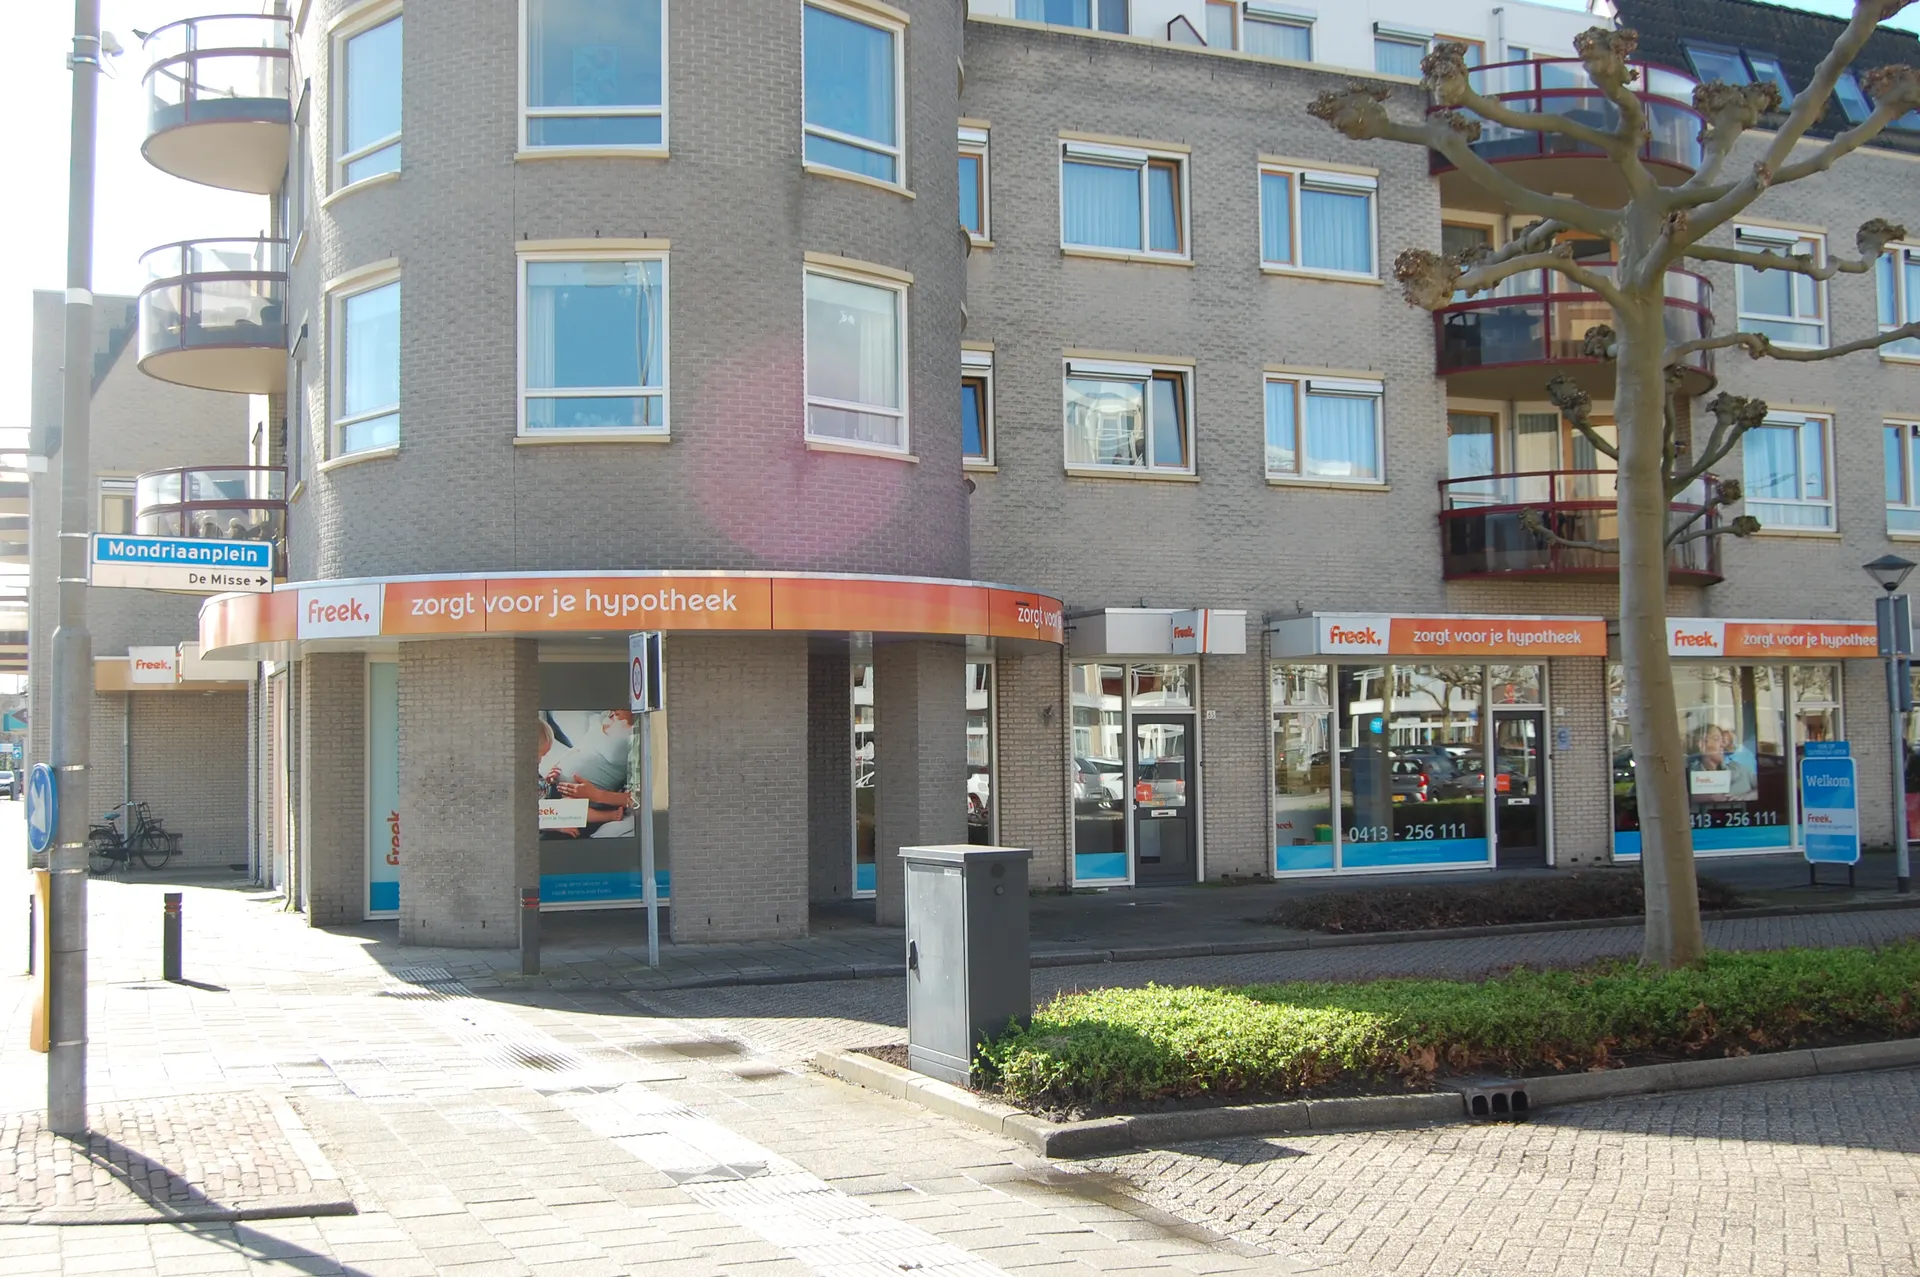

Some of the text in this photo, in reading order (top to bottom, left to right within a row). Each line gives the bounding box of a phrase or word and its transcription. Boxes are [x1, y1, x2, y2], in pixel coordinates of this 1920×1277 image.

[108, 540, 258, 563] Mondriaanplein
[189, 573, 251, 586] De Misse
[411, 592, 476, 620] zorgt
[482, 594, 544, 613] voor
[548, 588, 576, 618] je
[585, 588, 738, 617] hypotheek
[1018, 606, 1044, 629] zorgt
[1413, 628, 1451, 646] zorgt
[1454, 629, 1487, 644] voor
[1489, 628, 1503, 647] je
[1506, 629, 1582, 647] hypotheek
[1743, 632, 1775, 648] zorgt
[1777, 633, 1804, 646] voor
[1806, 632, 1817, 648] je
[1821, 632, 1877, 648] hypothee
[1805, 774, 1851, 787] Welkom
[1725, 811, 1750, 827] 256
[1754, 810, 1776, 825] 111
[1349, 825, 1389, 842] 0413
[1405, 824, 1434, 840] 256
[1439, 823, 1467, 839] 111
